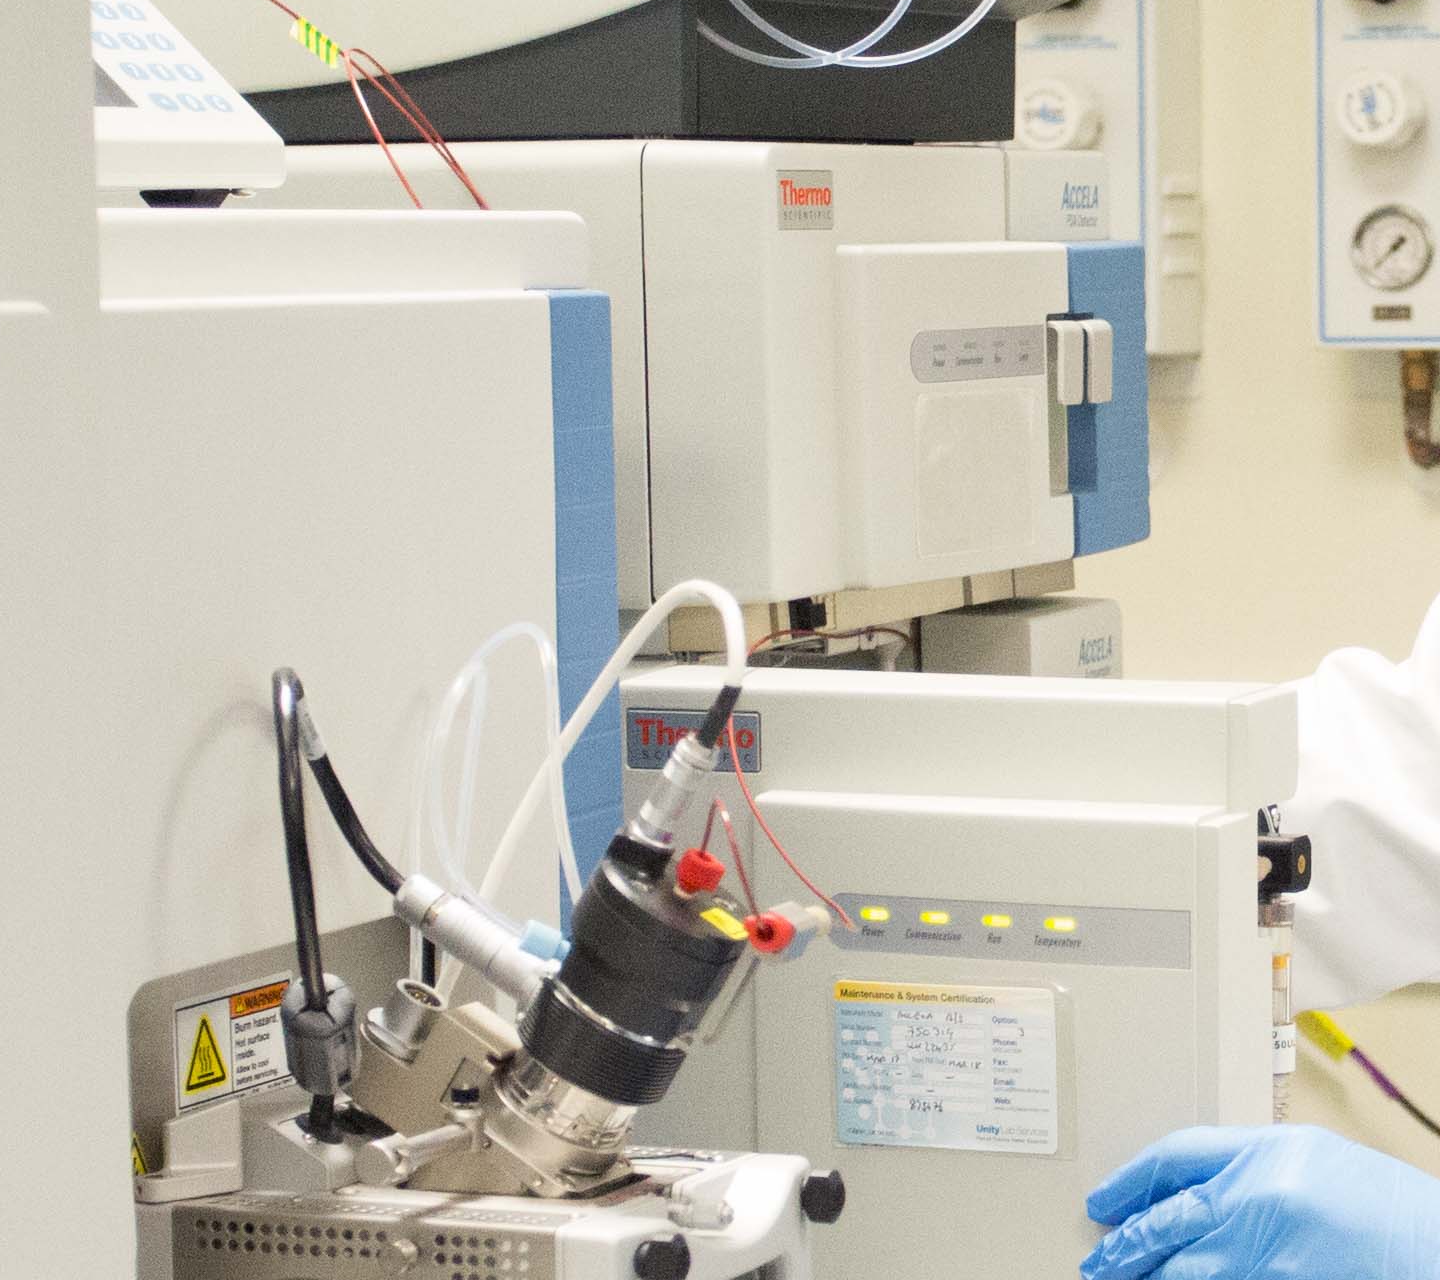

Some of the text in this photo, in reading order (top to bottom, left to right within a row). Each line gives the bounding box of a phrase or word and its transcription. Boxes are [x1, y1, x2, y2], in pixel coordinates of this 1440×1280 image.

[779, 179, 832, 206] Thermo
[1061, 181, 1099, 209] ACCELA
[861, 925, 886, 937] Power
[905, 928, 961, 942] Communication
[987, 933, 1002, 945] Run
[1034, 935, 1082, 949] Temperature
[840, 988, 995, 1004] Maintenance & System Certification
[234, 1022, 251, 1034] Burn
[247, 1032, 270, 1045] surface
[236, 1063, 251, 1074] Allow
[976, 1124, 1000, 1135] Unity
